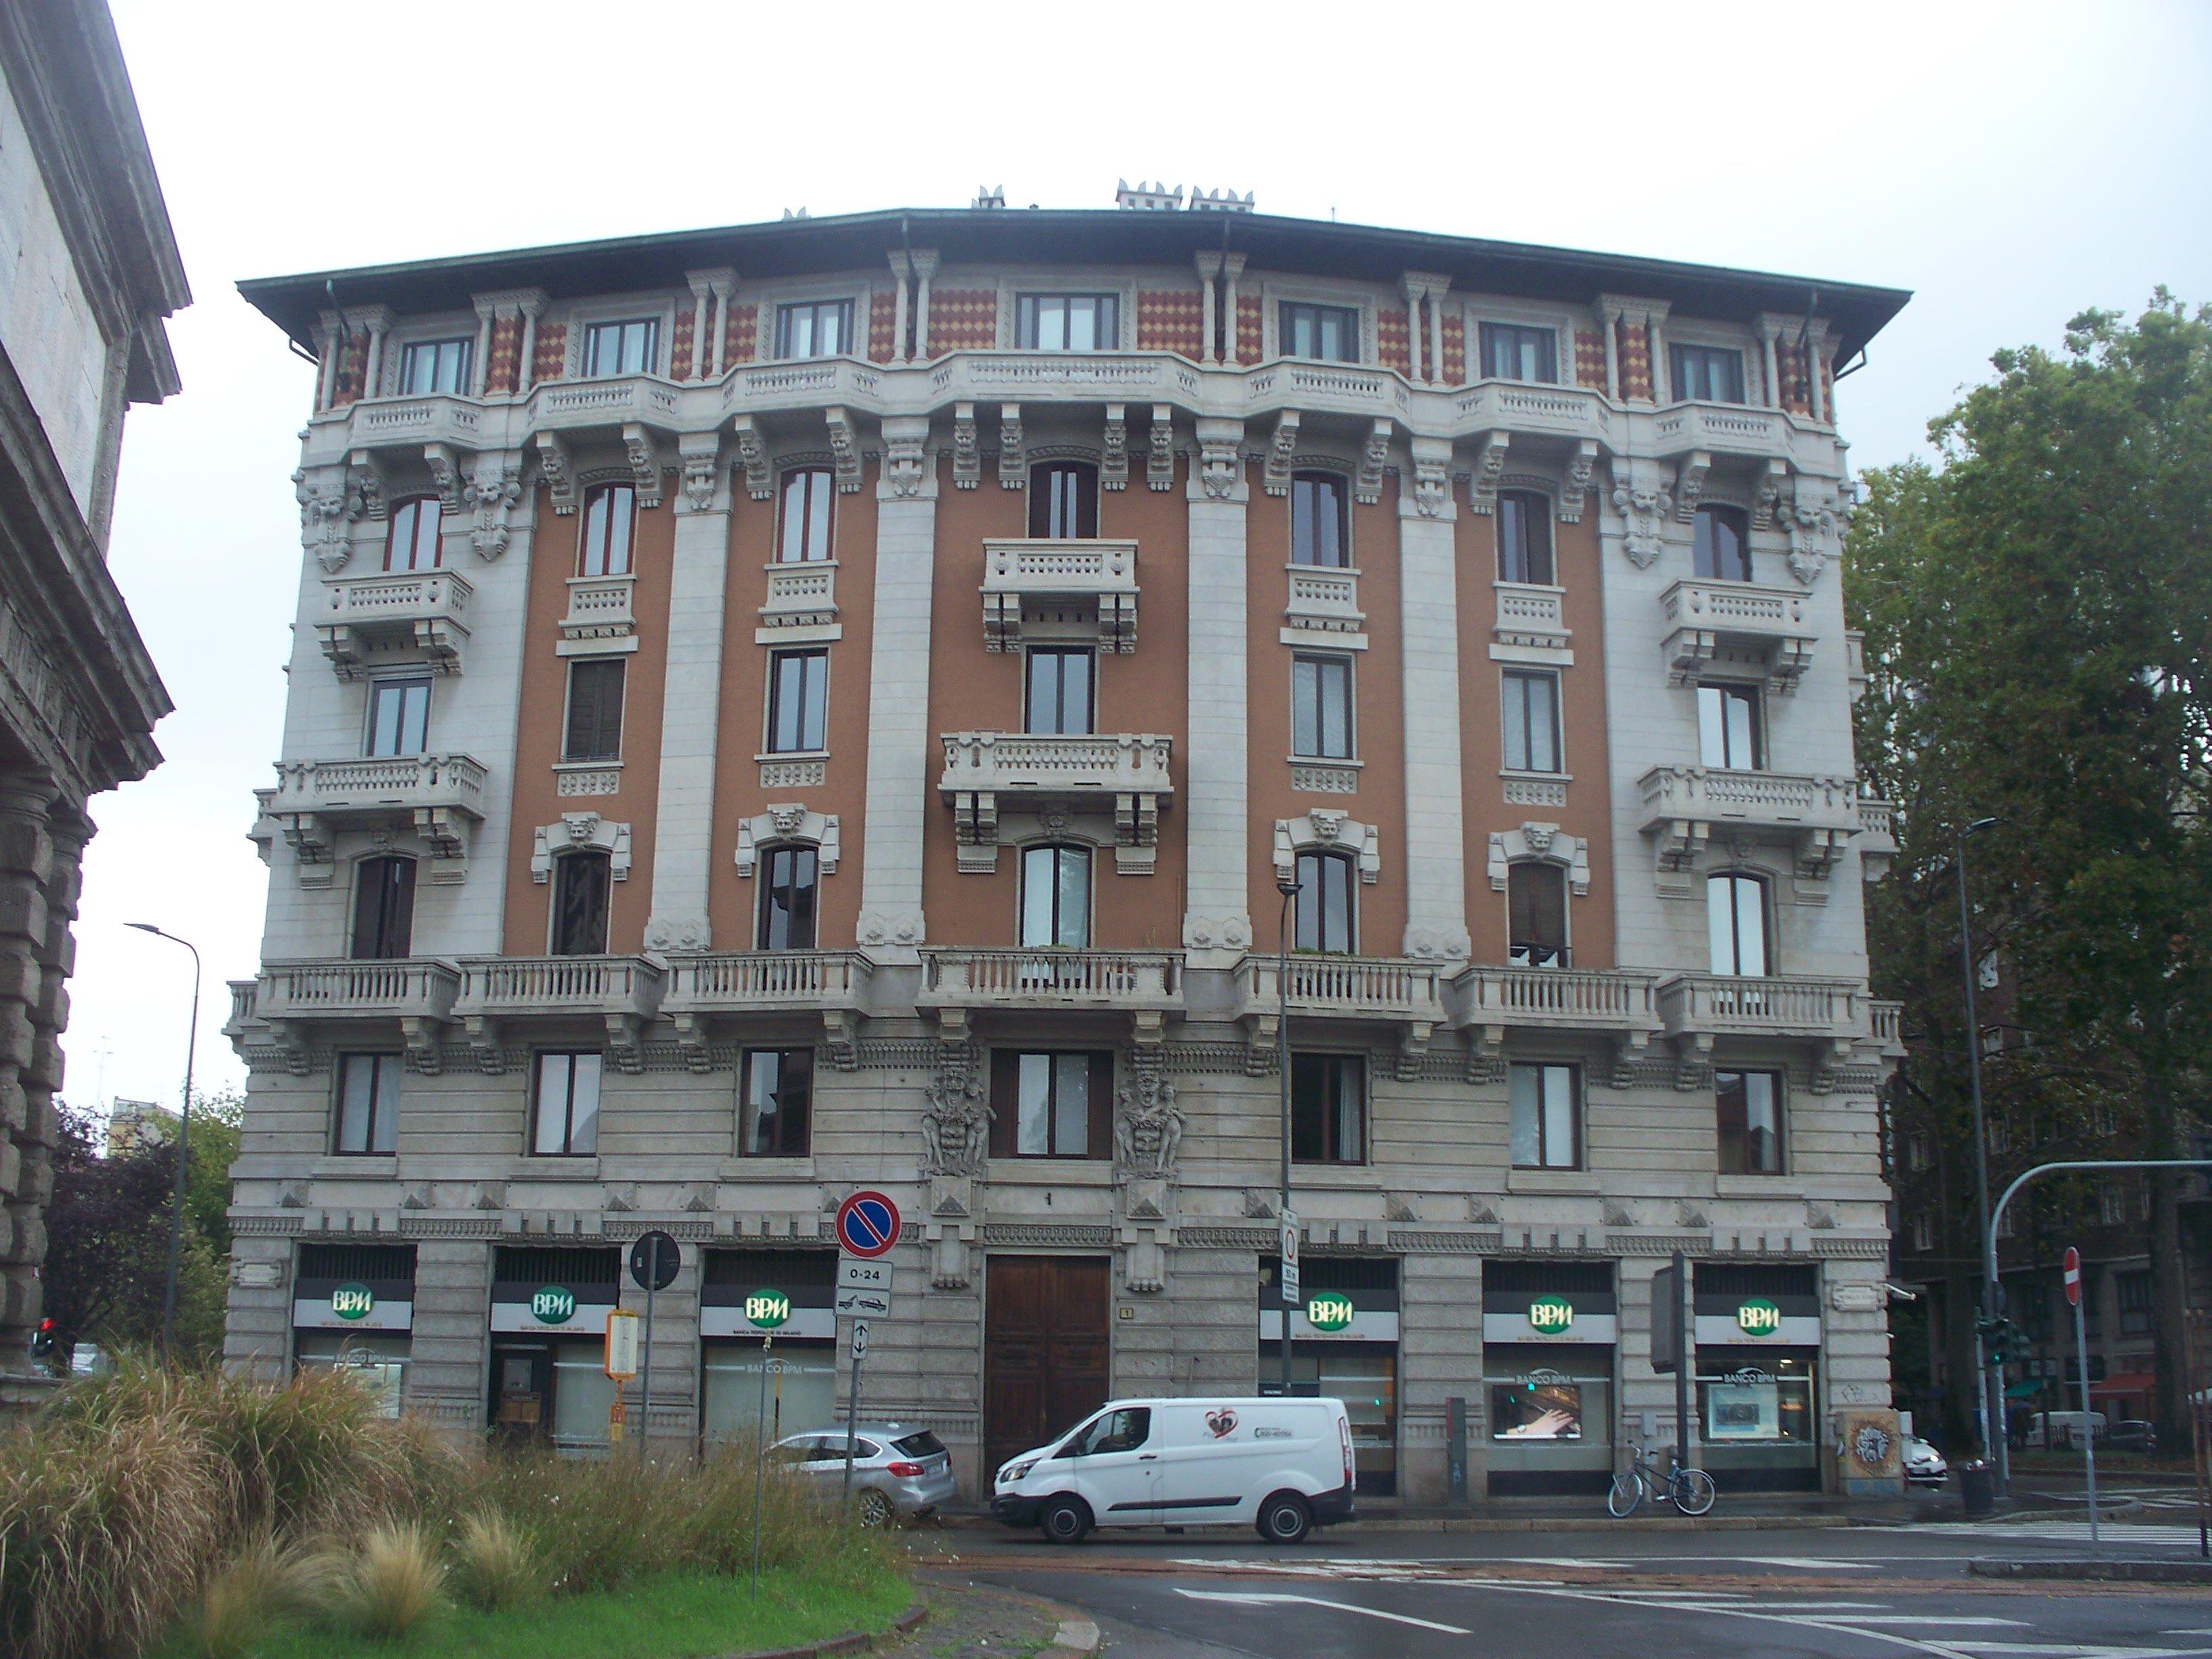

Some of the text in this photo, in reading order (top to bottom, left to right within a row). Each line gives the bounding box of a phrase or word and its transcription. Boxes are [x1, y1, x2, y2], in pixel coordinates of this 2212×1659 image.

[850, 1269, 880, 1280] 0-24
[333, 1290, 372, 1311] BPM
[533, 1293, 573, 1315] BPM
[746, 1297, 788, 1319] BPM
[1309, 1300, 1353, 1323] BPM
[1531, 1304, 1573, 1326] BPM
[1739, 1307, 1780, 1328] BPM
[747, 1364, 781, 1374] BANCO
[1516, 1374, 1571, 1384] BANCO BPM
[1723, 1373, 1776, 1383] BANCO BPM
